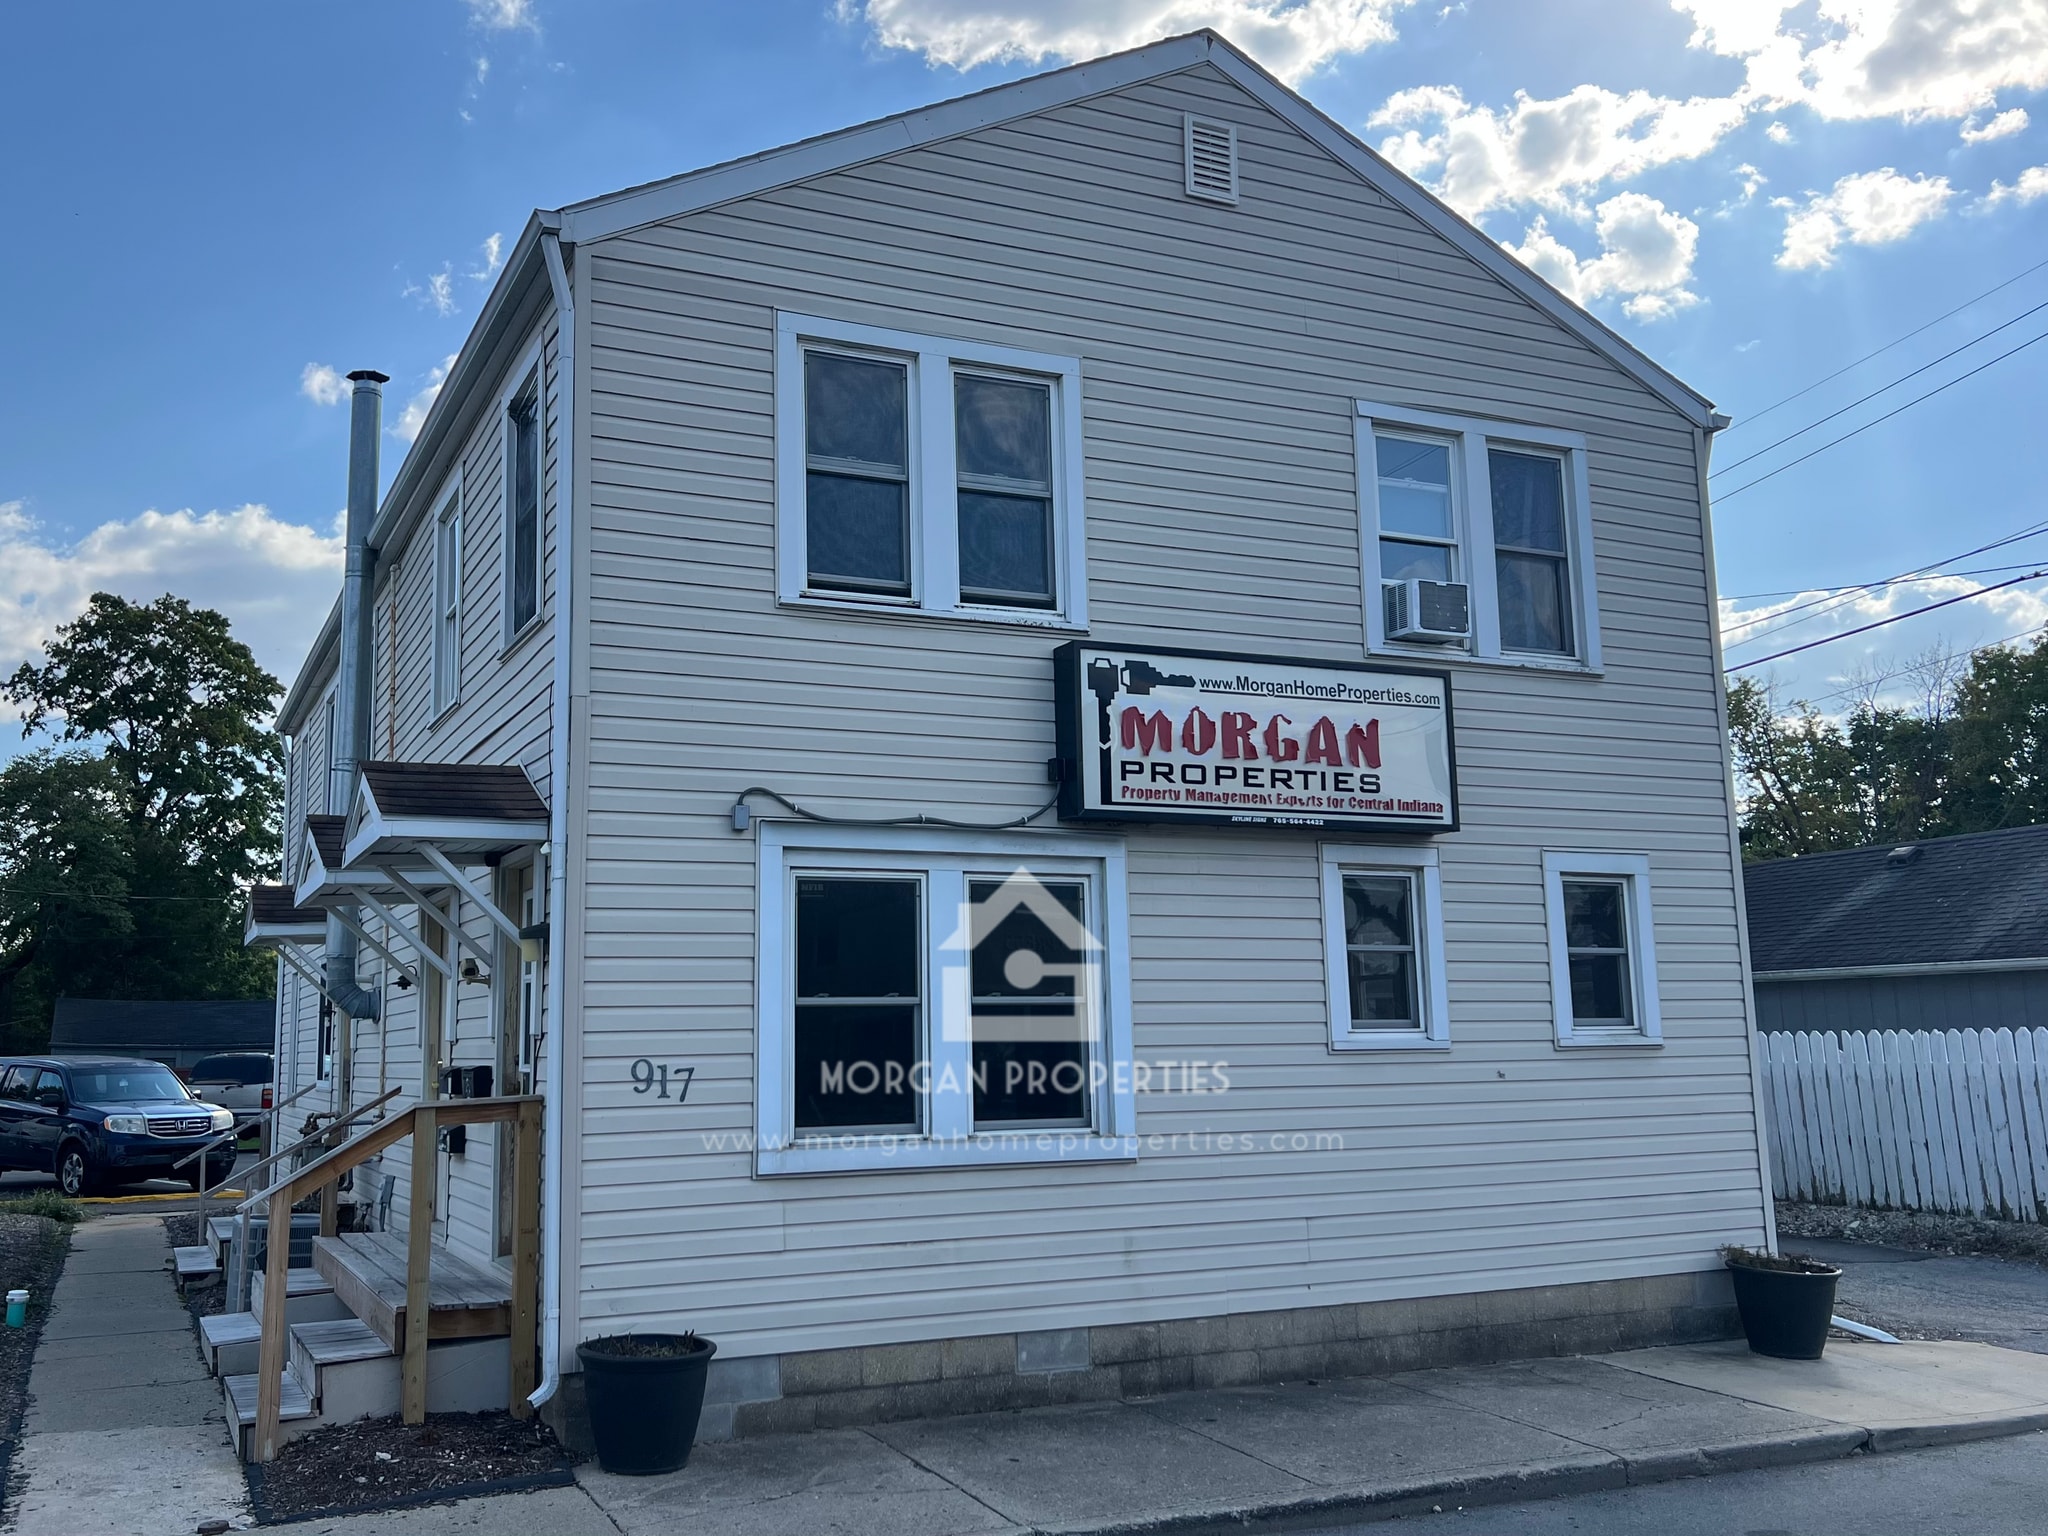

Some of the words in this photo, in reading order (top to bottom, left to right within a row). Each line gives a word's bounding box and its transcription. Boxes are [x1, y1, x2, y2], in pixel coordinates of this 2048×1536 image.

[1199, 676, 1440, 705] www.MorganHomeProperties.com
[1120, 705, 1381, 769] MORGAN
[1120, 760, 1381, 793] PROPERTIES
[1121, 785, 1180, 801] Property
[1185, 788, 1272, 805] Management
[1276, 793, 1324, 807] Experts
[1327, 795, 1345, 809] for
[1349, 796, 1394, 811] Central
[1398, 799, 1443, 813] Indiana
[631, 1059, 694, 1102] 917
